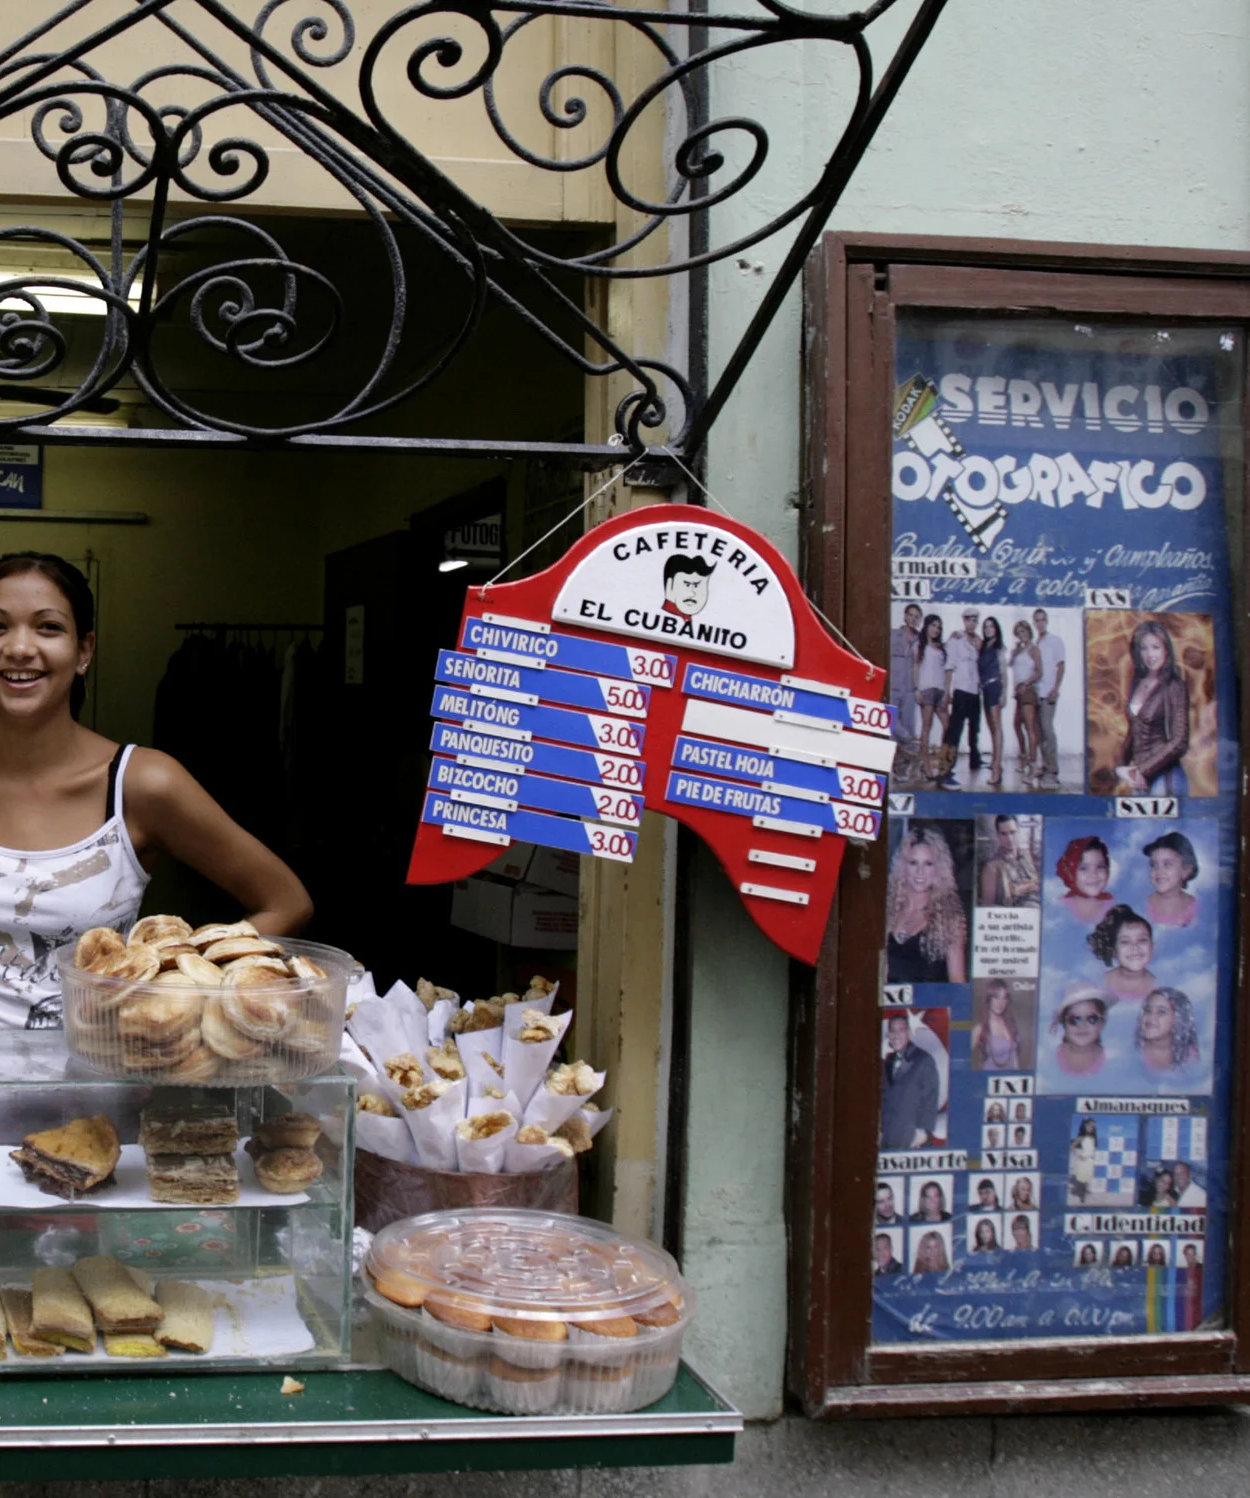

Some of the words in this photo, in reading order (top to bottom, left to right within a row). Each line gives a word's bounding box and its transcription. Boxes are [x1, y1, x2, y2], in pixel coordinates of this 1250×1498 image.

[892, 387, 923, 430] KODAK
[938, 373, 1209, 434] SERVICIO
[891, 450, 1207, 510] OTOGRAFICO
[613, 531, 770, 595] CAFETERIA
[892, 559, 971, 576] rmatos
[579, 599, 612, 622] EL
[624, 609, 748, 650] CUBANITO
[470, 625, 559, 657] CHIVIRICO
[445, 657, 521, 688] SEÑORITA
[632, 654, 673, 681] 3.00
[606, 686, 647, 711] 5.00
[690, 670, 795, 708] CHICHARRÓN
[439, 694, 520, 725] MELITÓNG
[852, 703, 892, 729] 5.00
[440, 729, 534, 763] PANQUESITO
[598, 723, 641, 749] 3.00
[600, 760, 642, 786] 2.00
[681, 743, 733, 771] PASTEL
[734, 757, 774, 779] HOJA
[438, 765, 518, 796] BIZCOCHO
[840, 775, 882, 800] 3.00
[597, 795, 640, 821] 2.00
[675, 779, 701, 799] PIE
[702, 783, 722, 802] DE
[722, 787, 781, 815] FRUTAS
[432, 800, 507, 831] PRINCESA
[835, 809, 877, 835] 3.00
[590, 831, 633, 856] 3.00
[1082, 1099, 1188, 1114] Almanaques
[878, 1152, 967, 1172] asaporte
[985, 1152, 1033, 1168] Visa
[1095, 1214, 1206, 1233] Identidad
